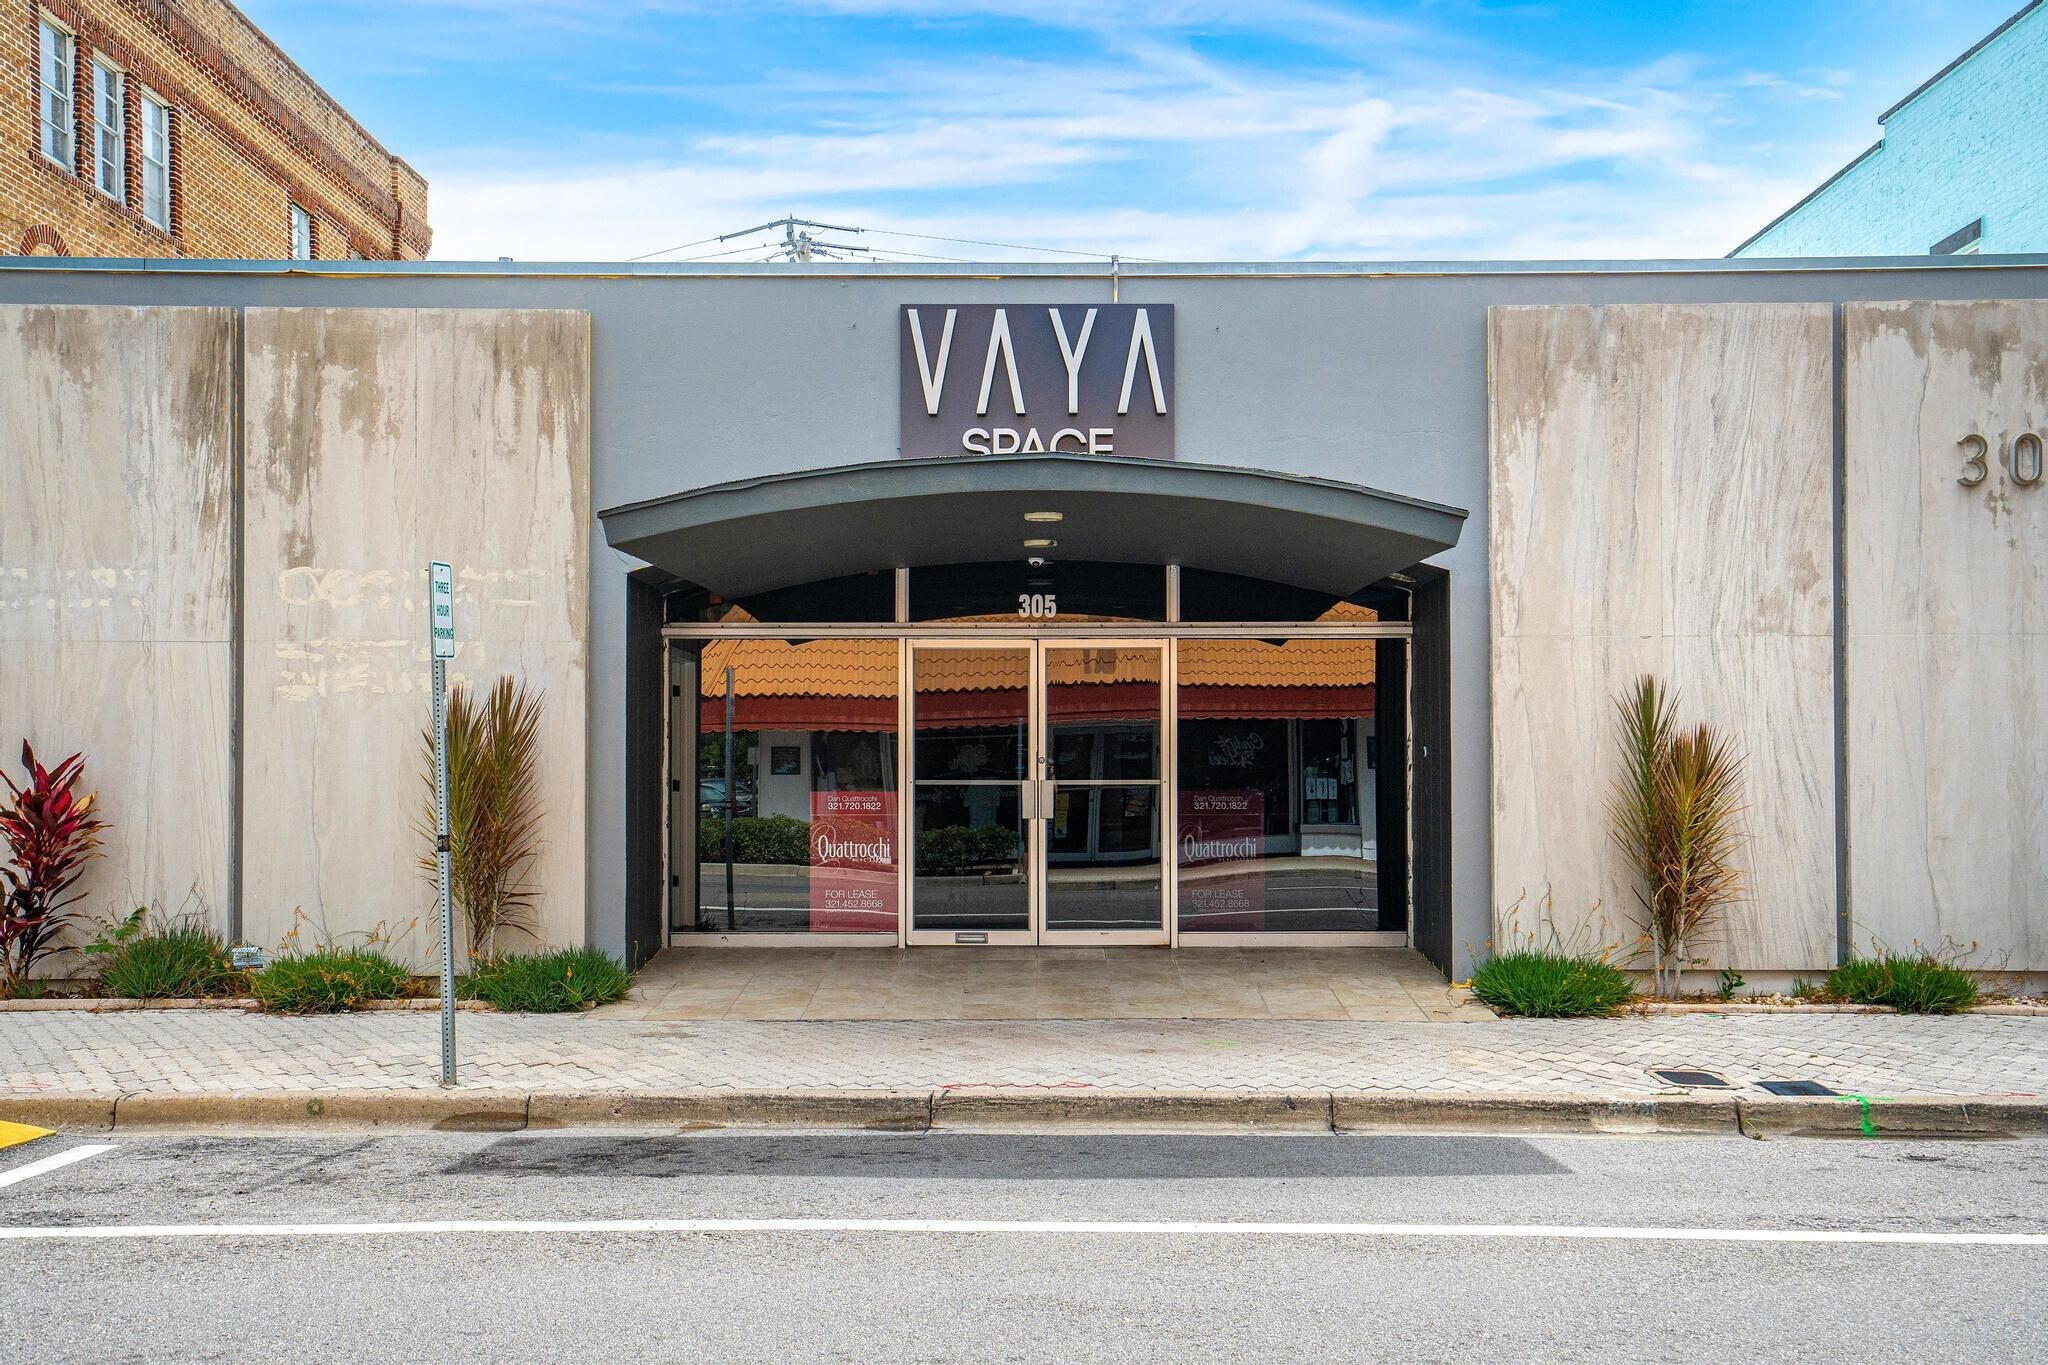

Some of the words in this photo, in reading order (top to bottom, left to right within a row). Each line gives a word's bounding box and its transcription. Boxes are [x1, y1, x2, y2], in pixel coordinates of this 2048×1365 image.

[907, 308, 1167, 415] VAYA
[962, 427, 1115, 455] SPACE
[1957, 432, 2043, 488] 30
[435, 581, 450, 595] THREE
[436, 604, 450, 617] HOUR
[1018, 594, 1057, 618] 305
[434, 627, 454, 640] PARKING
[827, 802, 882, 810] 321.720.1822
[1193, 802, 1248, 810] 321.720.1822
[818, 835, 890, 862] Quattrocchi
[1184, 834, 1257, 862] Quattrocchi
[825, 889, 845, 899] FOR
[847, 889, 878, 899] LEASE
[1191, 889, 1212, 899] FOR
[1214, 889, 1245, 899] LEASE
[825, 900, 883, 908] 321.452.8668
